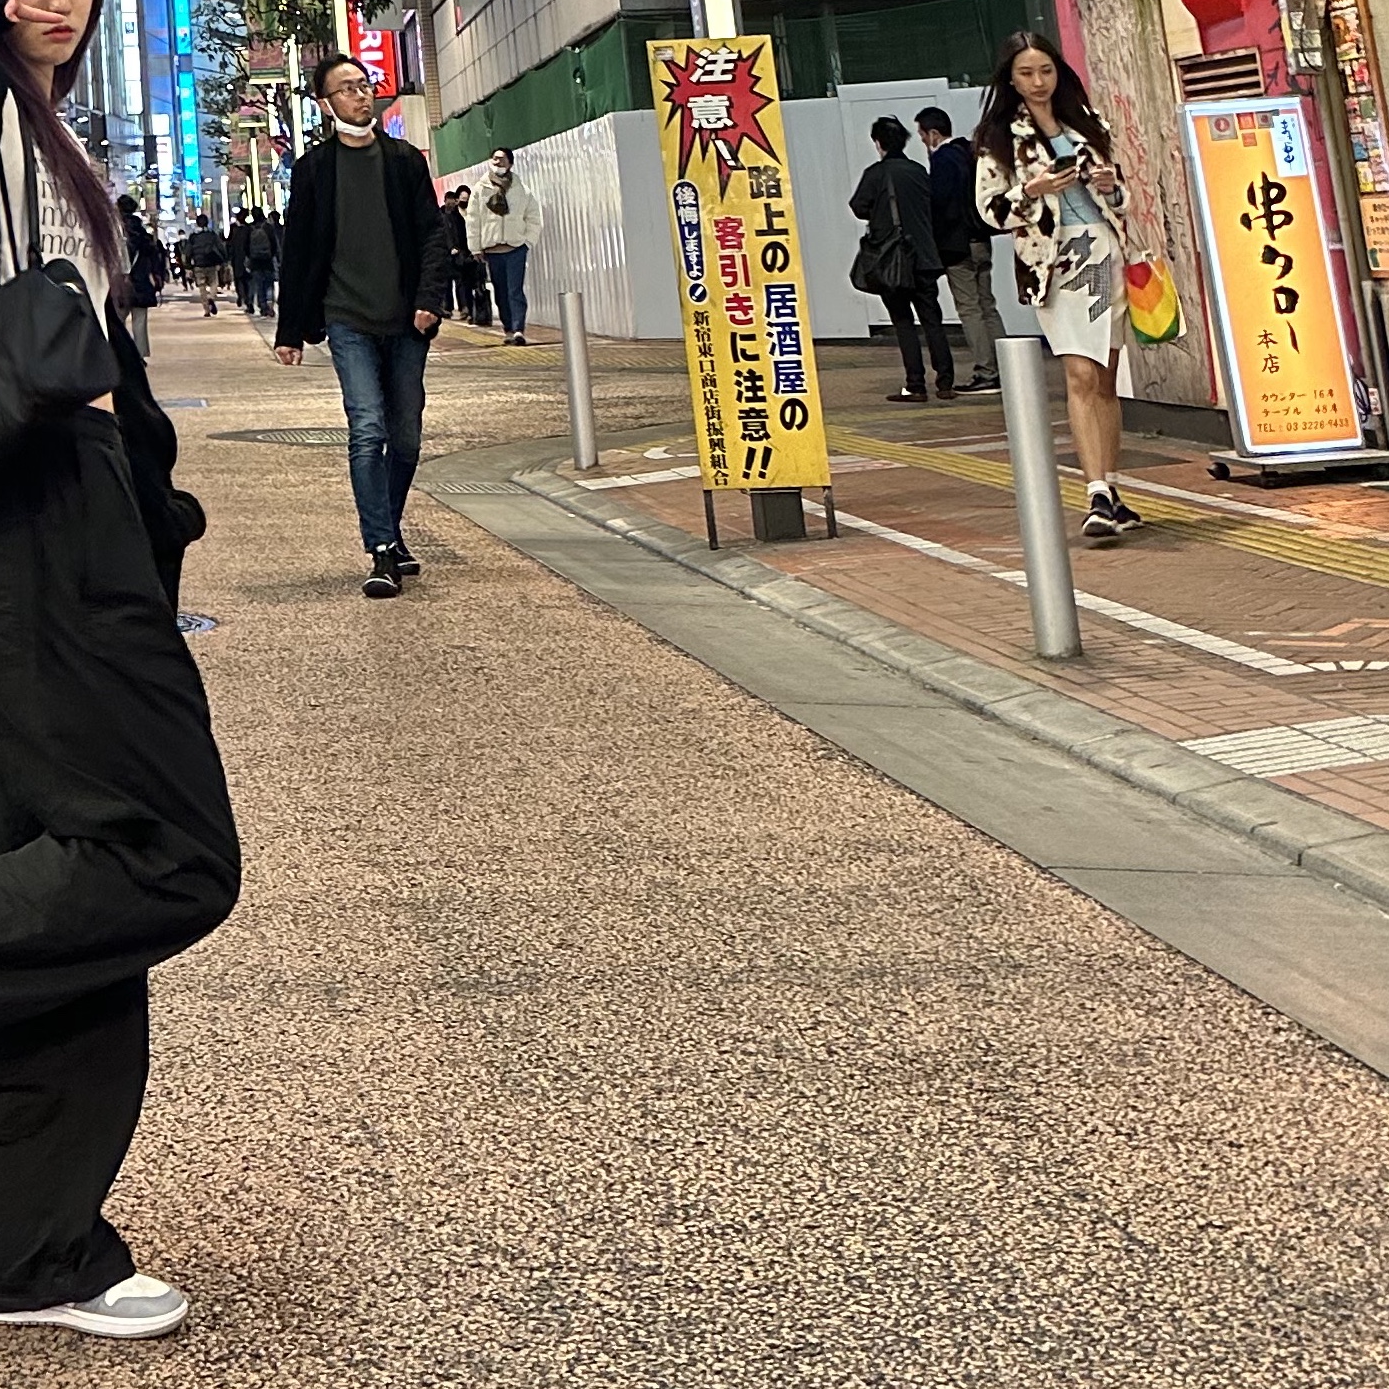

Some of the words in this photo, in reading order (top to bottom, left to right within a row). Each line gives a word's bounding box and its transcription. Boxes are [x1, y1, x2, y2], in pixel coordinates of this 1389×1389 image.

[747, 165, 810, 432] 路上の居酒屋の
[1239, 170, 1301, 355] 串クロー
[1256, 329, 1281, 375] 本店
[692, 309, 730, 488] 新宿東口商店街振興組合
